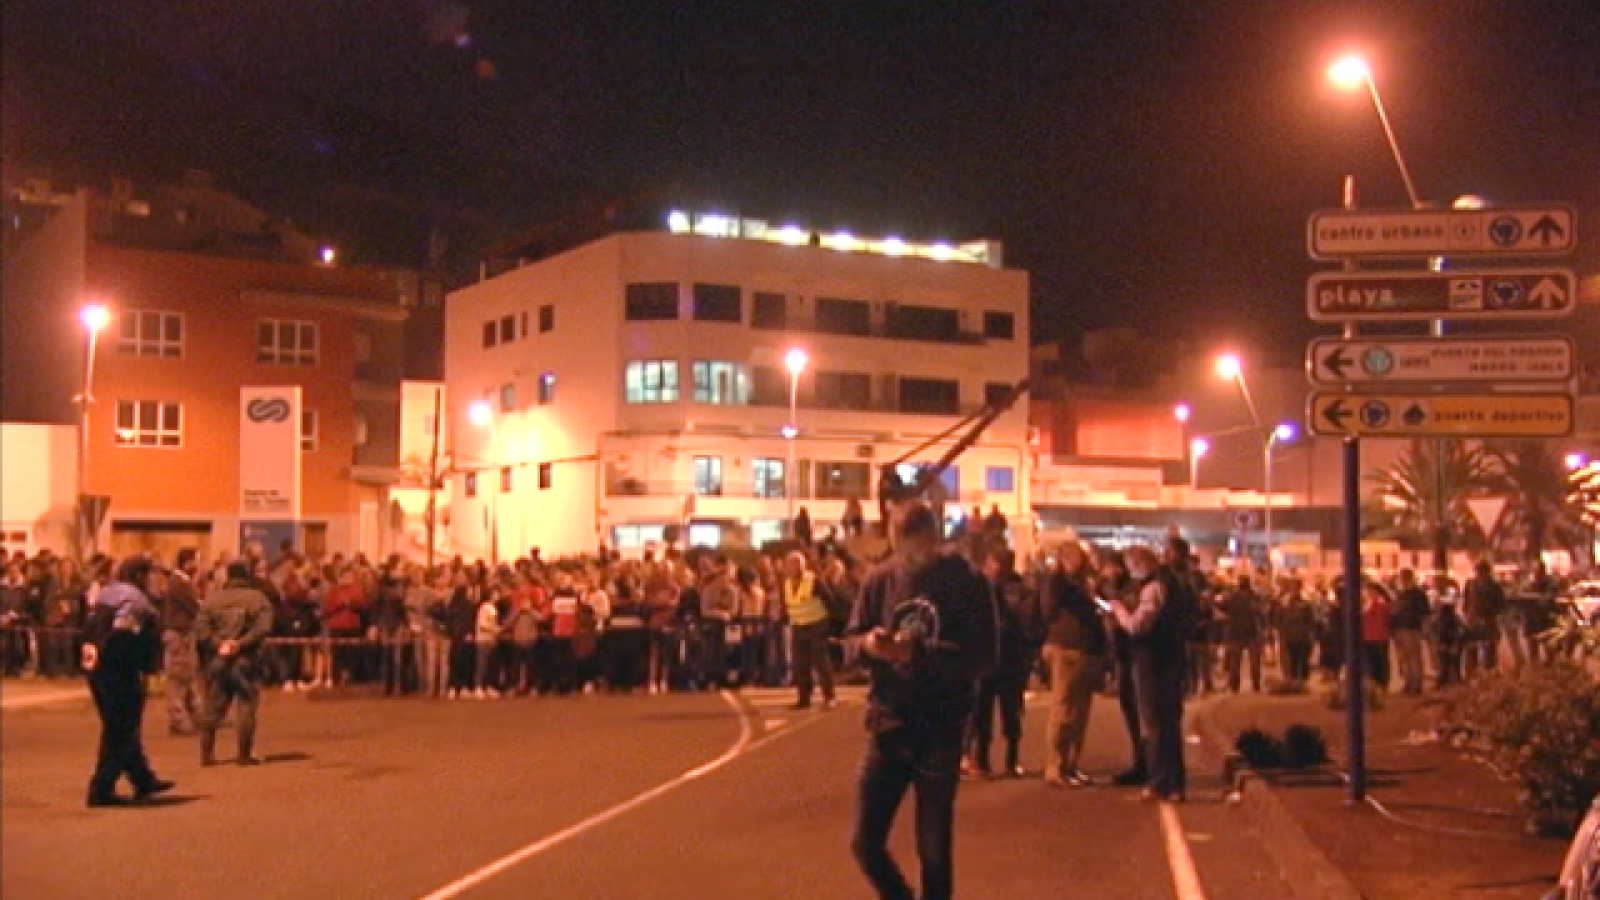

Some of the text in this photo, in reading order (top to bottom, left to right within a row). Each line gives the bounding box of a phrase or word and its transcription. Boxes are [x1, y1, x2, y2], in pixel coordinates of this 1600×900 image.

[1320, 224, 1444, 241] centro urbano
[1320, 284, 1394, 308] playa
[1434, 409, 1565, 423] puerto deportivo
